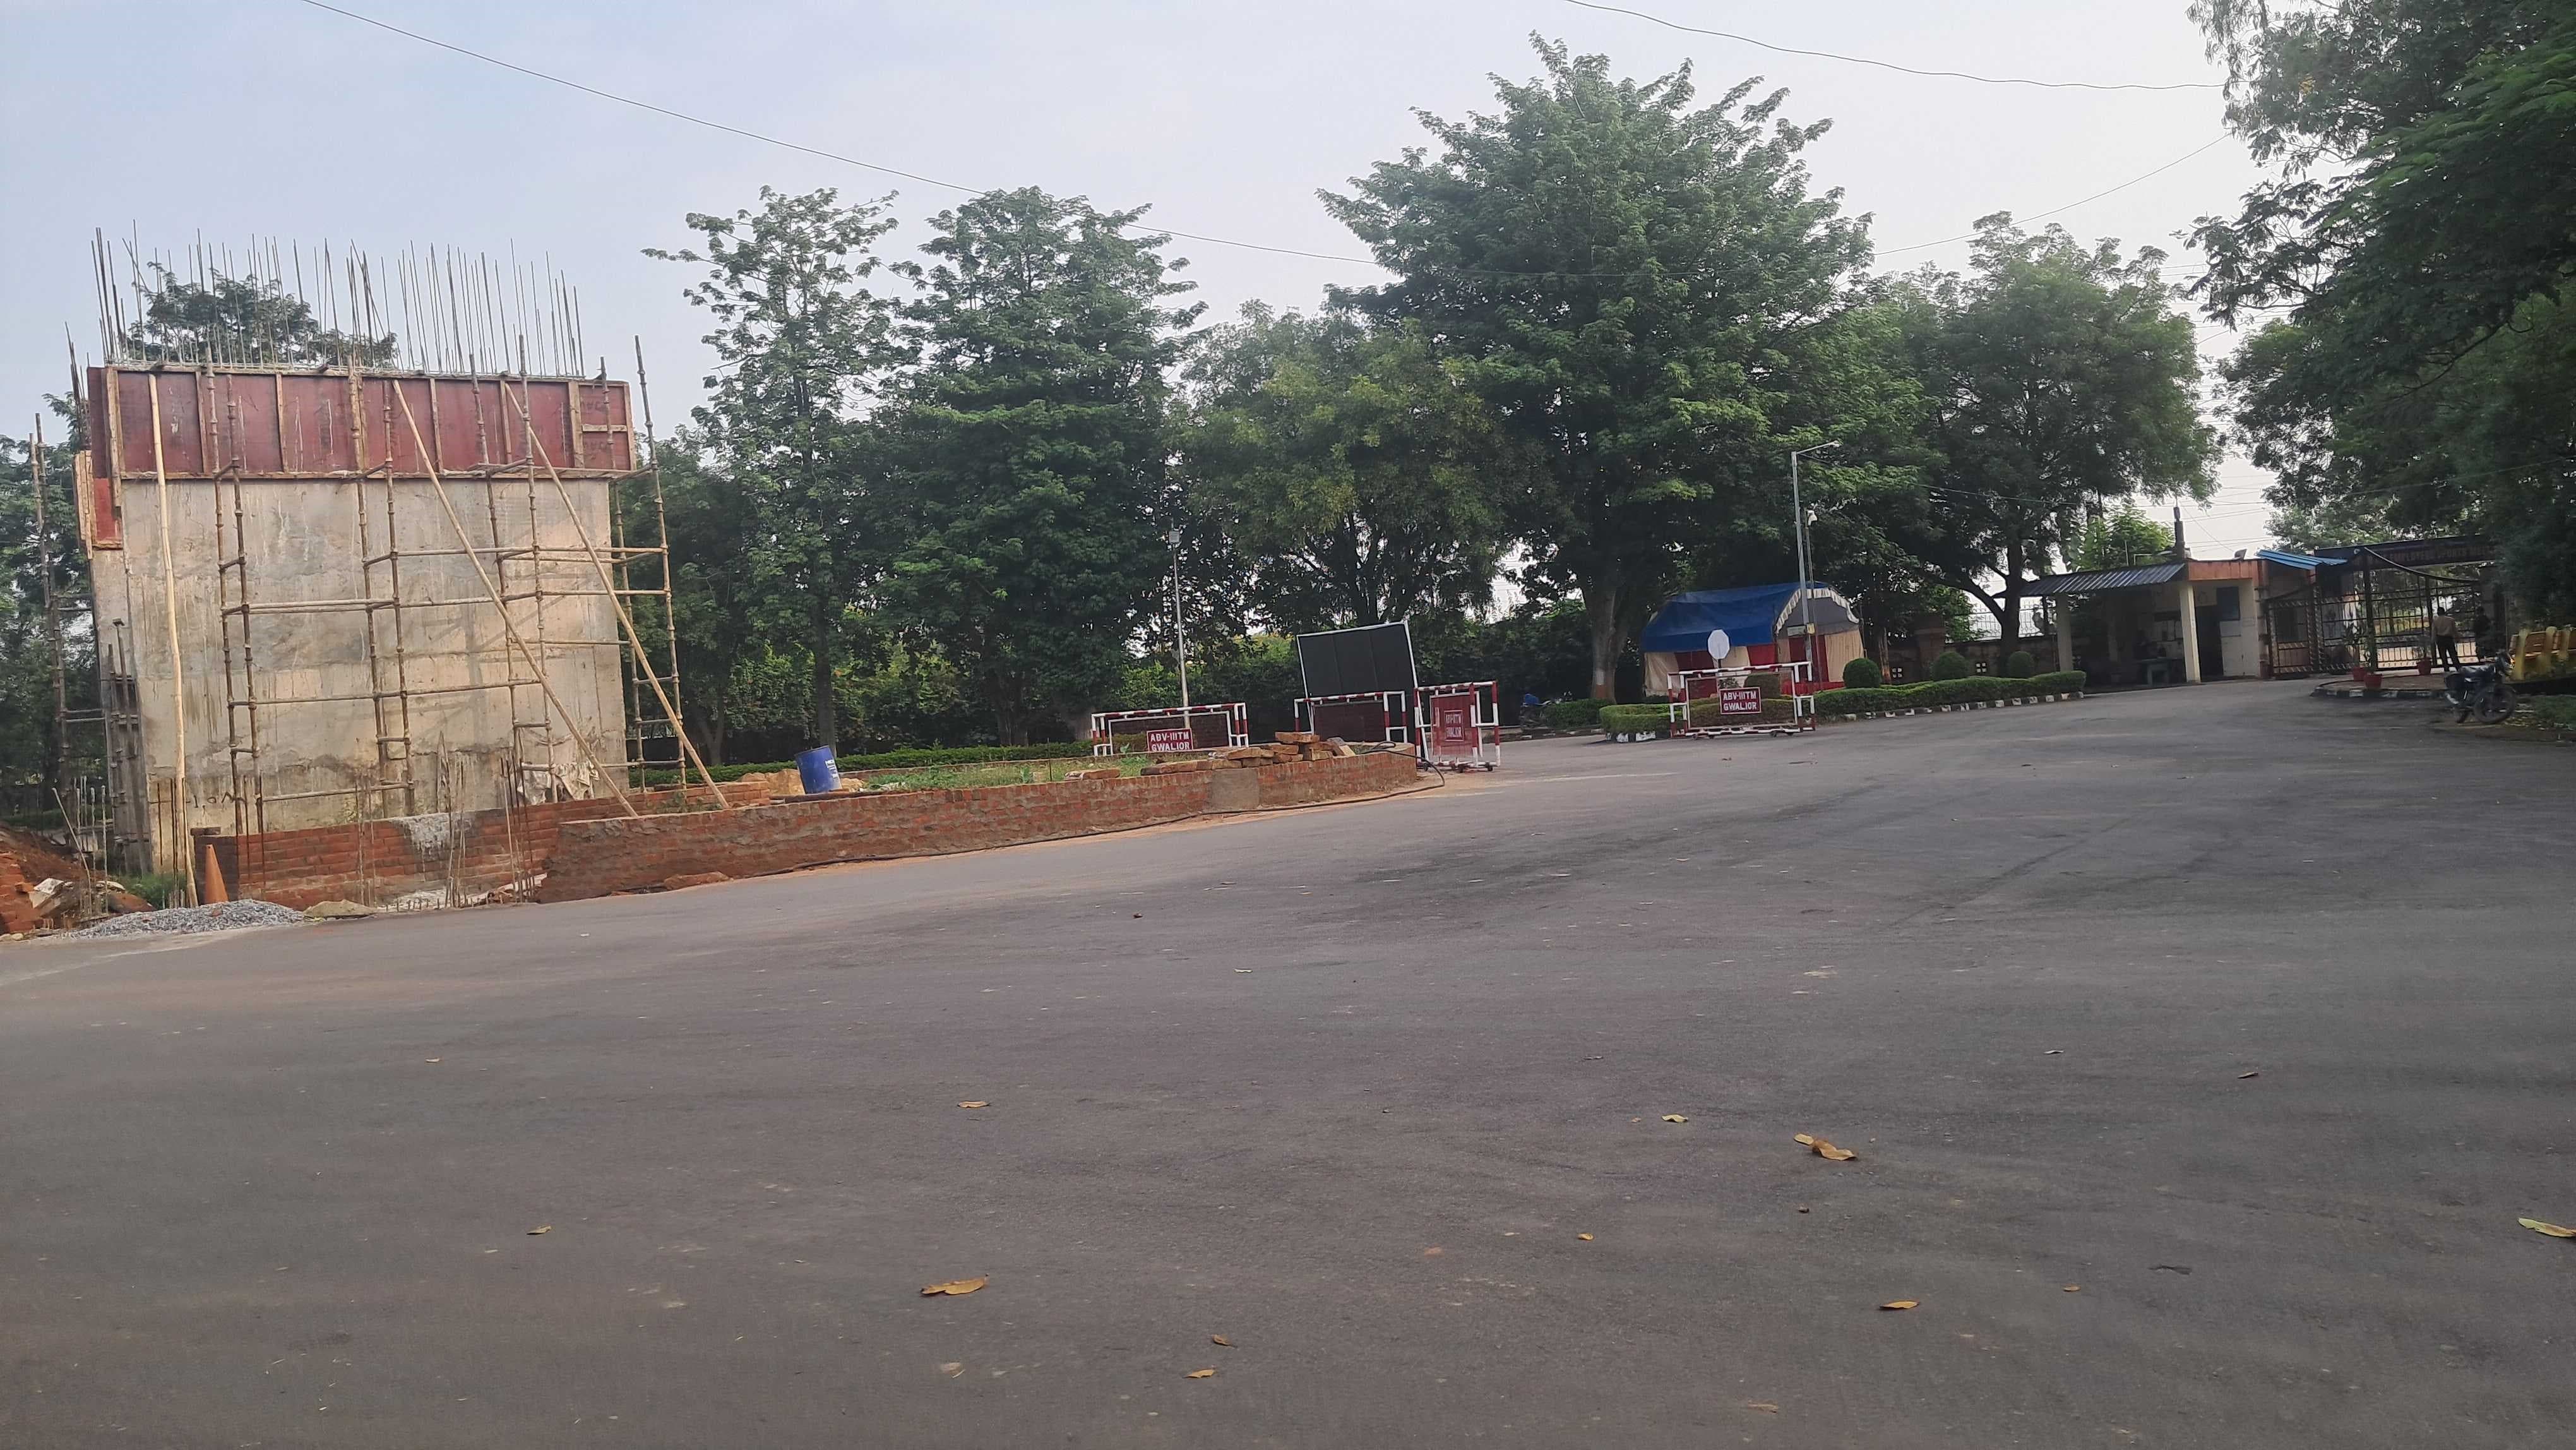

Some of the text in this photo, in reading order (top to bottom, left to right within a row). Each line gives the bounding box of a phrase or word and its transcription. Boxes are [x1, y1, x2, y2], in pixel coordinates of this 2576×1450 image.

[1723, 691, 1756, 700] ABV-IIITM
[1723, 702, 1757, 711] GWALIOR
[1150, 731, 1189, 742] ABV-IIITM
[1151, 741, 1190, 752] GWALIOR
